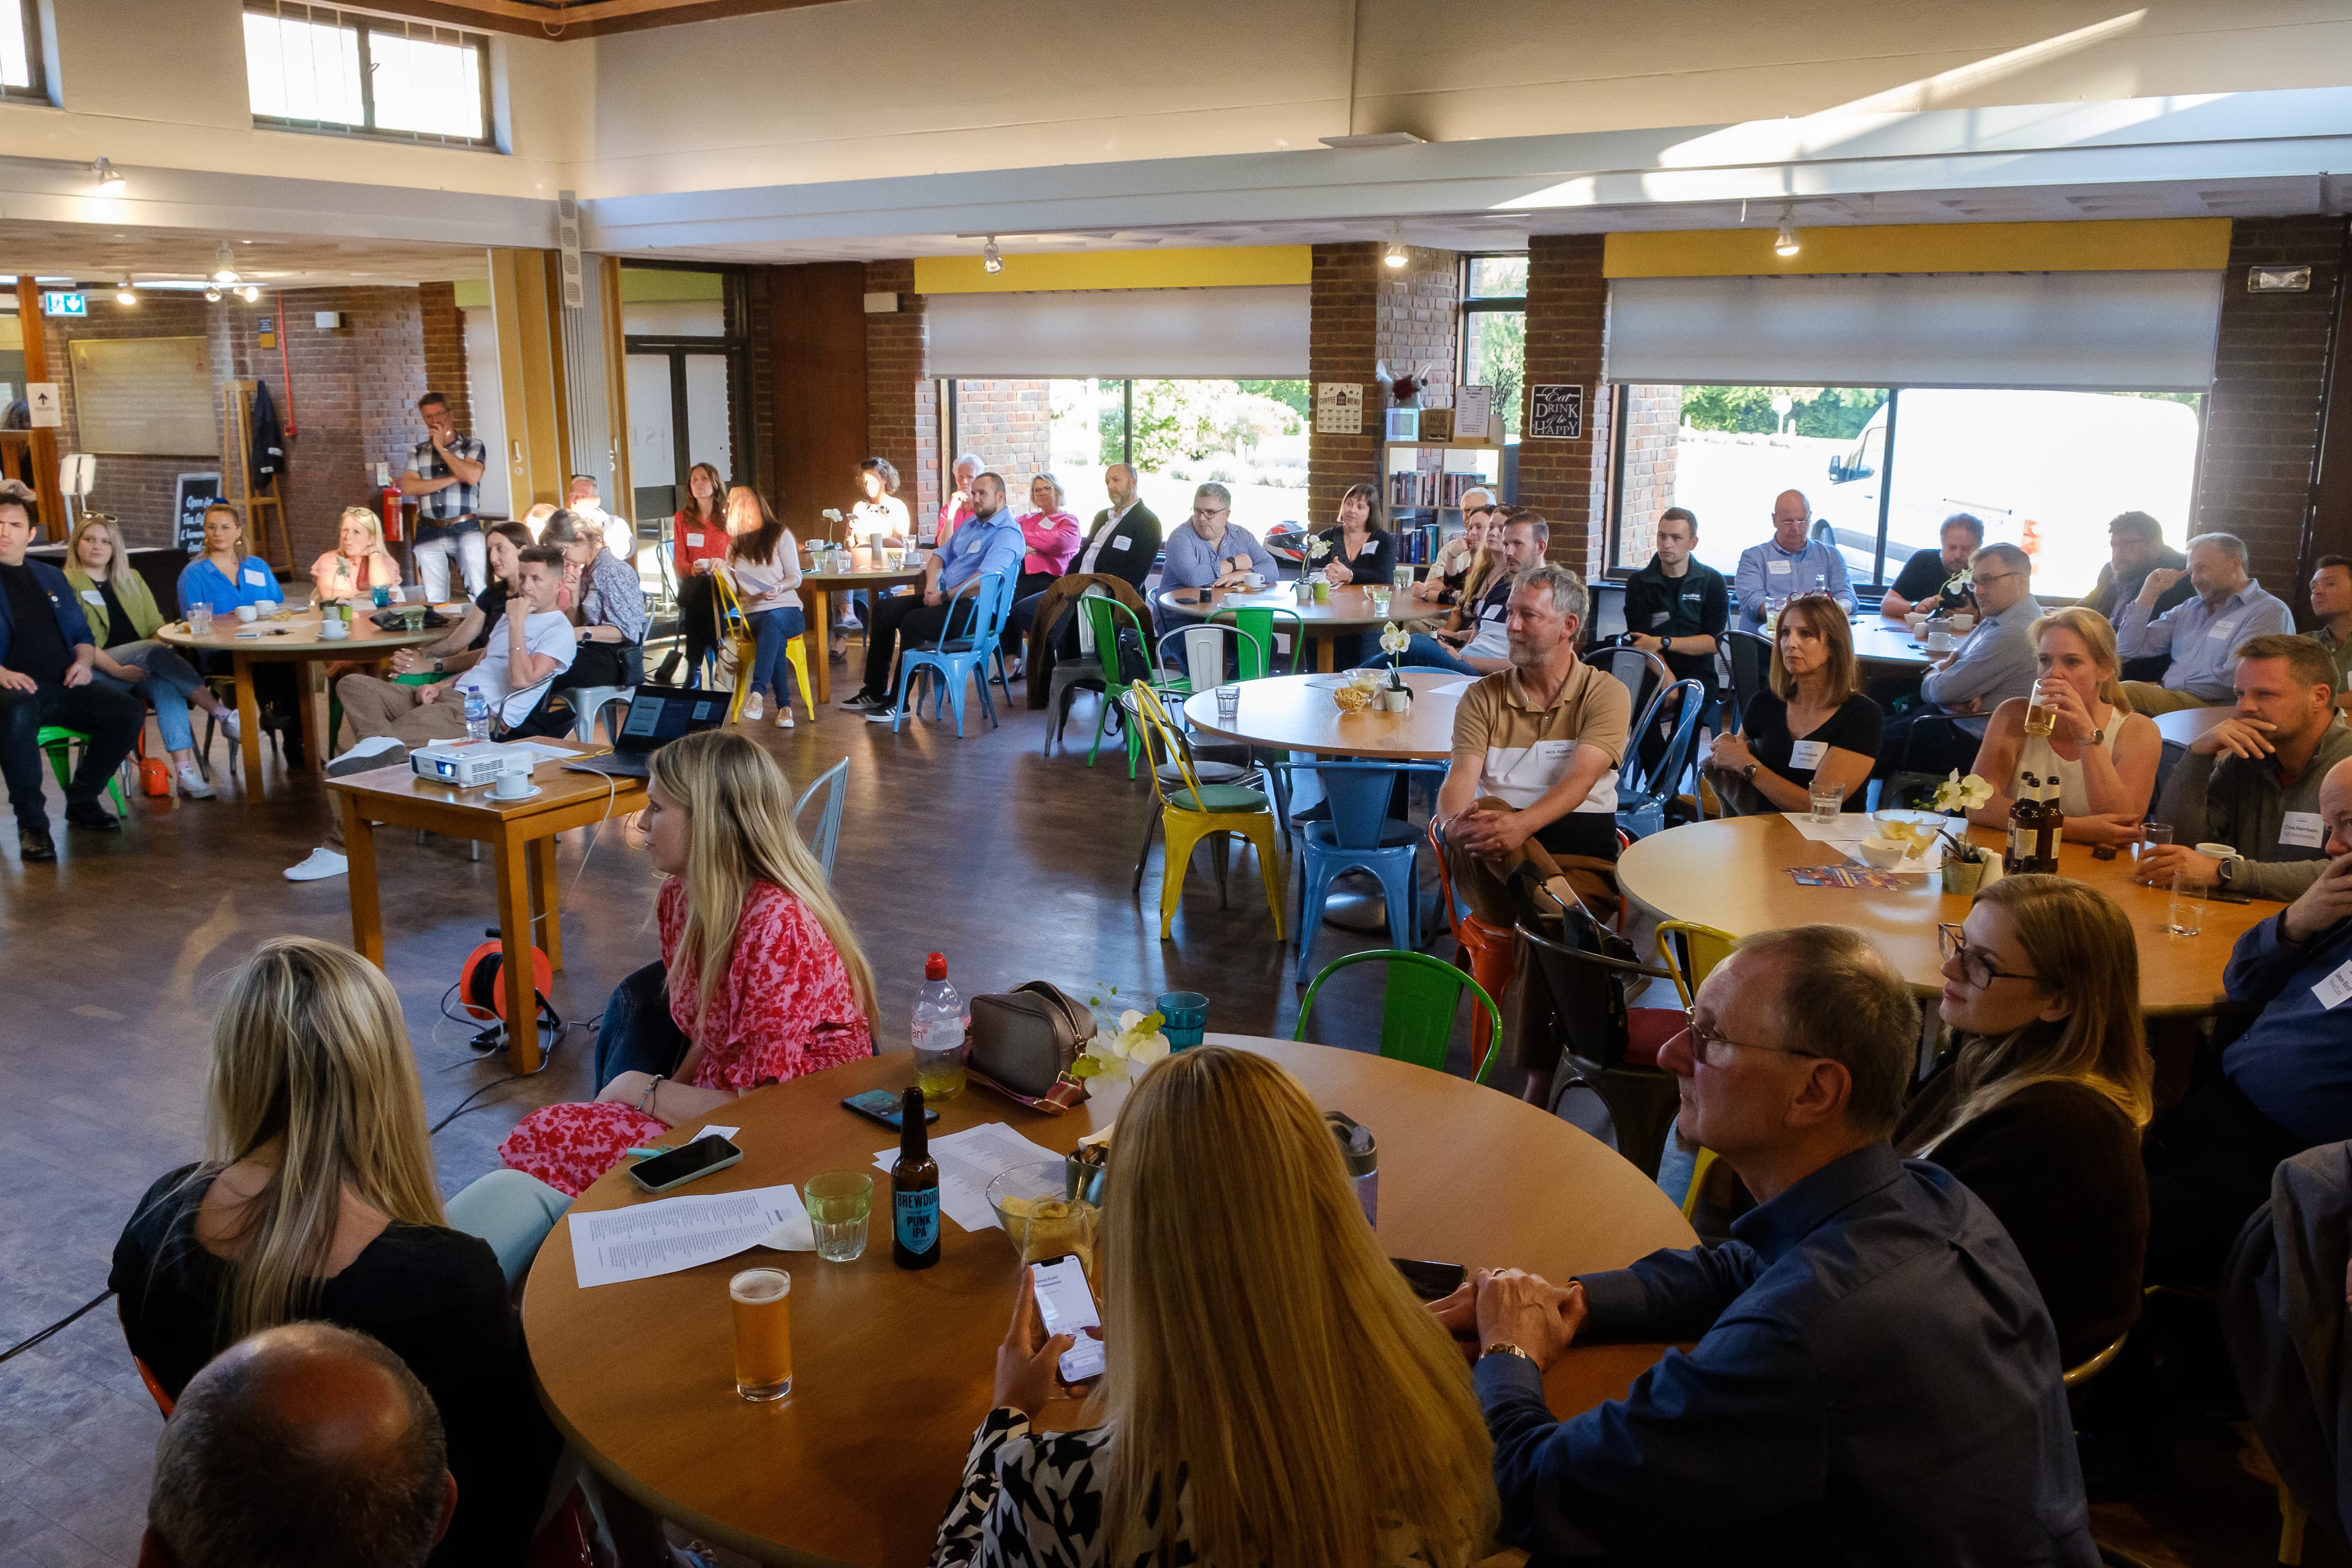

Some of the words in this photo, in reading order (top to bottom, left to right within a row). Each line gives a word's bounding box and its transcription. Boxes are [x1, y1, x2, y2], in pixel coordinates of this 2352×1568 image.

[1319, 396, 1336, 404] COFFEE
[1347, 397, 1361, 405] MENU
[1542, 387, 1571, 403] Eat
[1535, 403, 1578, 418] DRINK
[1556, 414, 1567, 424] be
[1534, 420, 1578, 435] HAPPY
[897, 1189, 938, 1208] BREWDOG
[907, 1214, 931, 1227] PUNK
[913, 1227, 927, 1238] IPA
